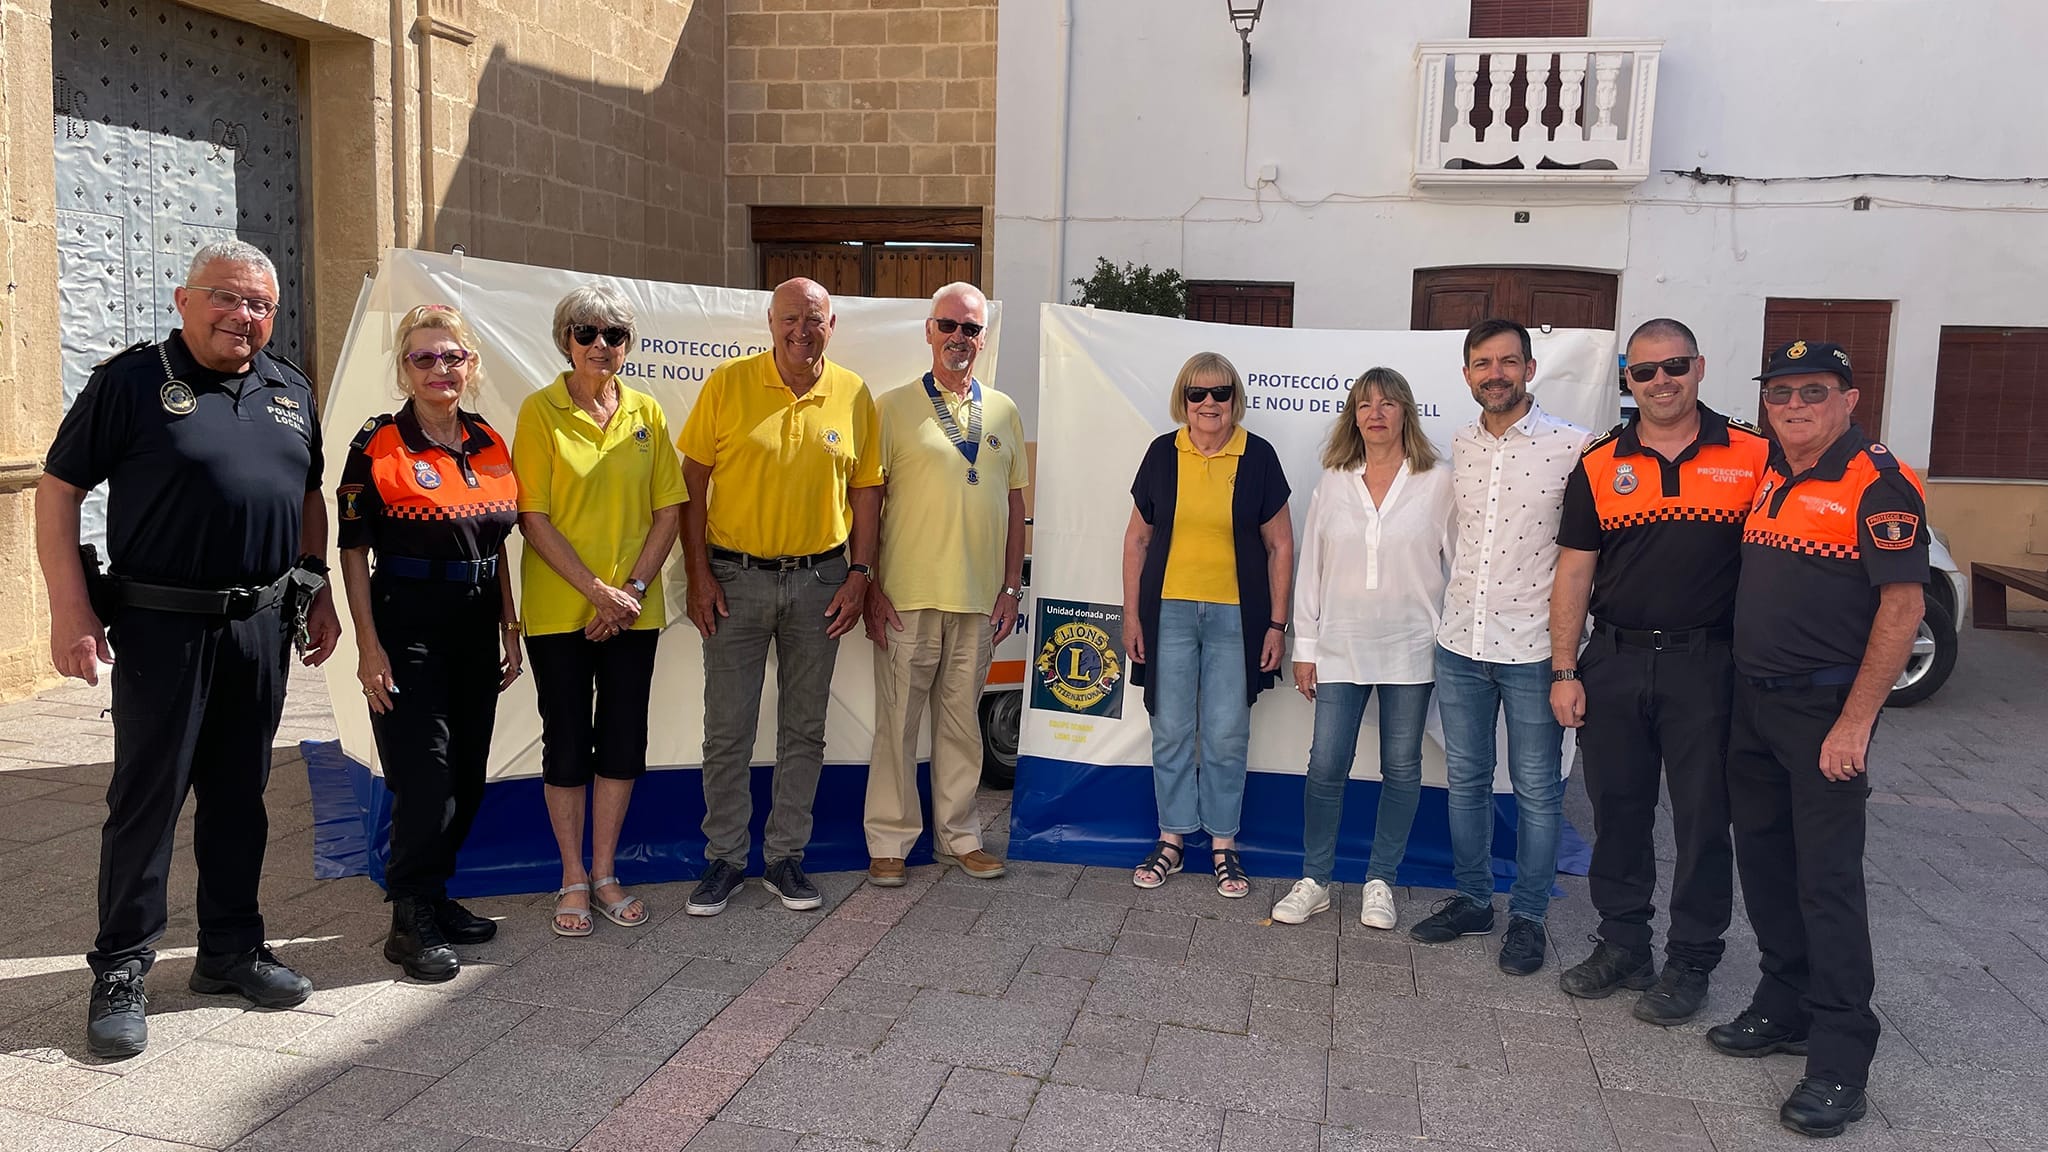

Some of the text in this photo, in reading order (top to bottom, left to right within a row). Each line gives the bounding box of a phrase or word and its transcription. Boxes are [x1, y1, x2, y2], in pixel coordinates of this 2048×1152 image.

[1519, 212, 1526, 222] 2
[641, 338, 741, 358] PROTECCIÓ
[663, 365, 704, 381] NOU
[1248, 373, 1339, 391] PROTECCIÓ
[1266, 397, 1304, 411] NOU
[1310, 399, 1330, 413] DE
[274, 414, 304, 432] LOCAL
[1713, 475, 1738, 483] CIVIL
[1046, 605, 1121, 621] Unidad donada por:
[1060, 626, 1105, 645] LIONS
[1066, 647, 1091, 682] L
